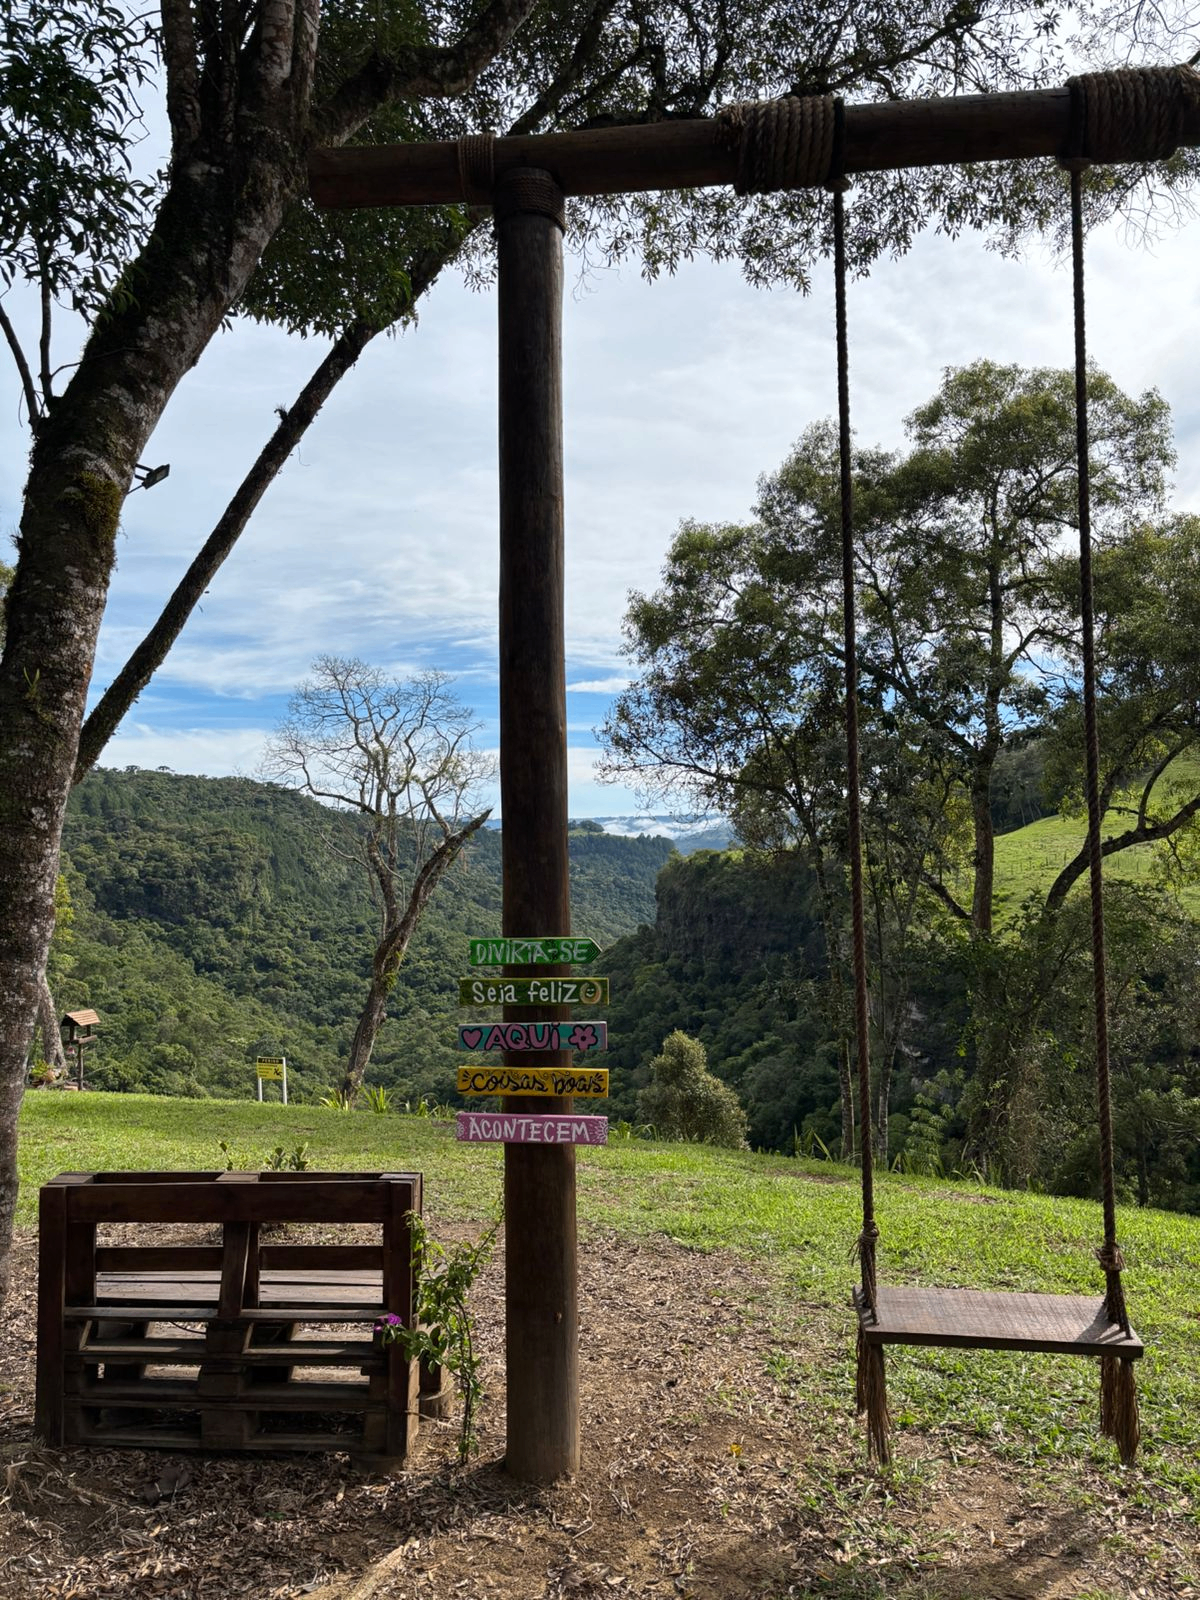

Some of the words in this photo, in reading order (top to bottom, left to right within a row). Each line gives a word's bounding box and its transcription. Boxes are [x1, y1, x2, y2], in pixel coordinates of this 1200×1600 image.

[472, 981, 518, 1003] Seja
[528, 980, 580, 1003] feliz
[552, 1073, 606, 1095] boas
[469, 1117, 590, 1142] ACONTECEM
